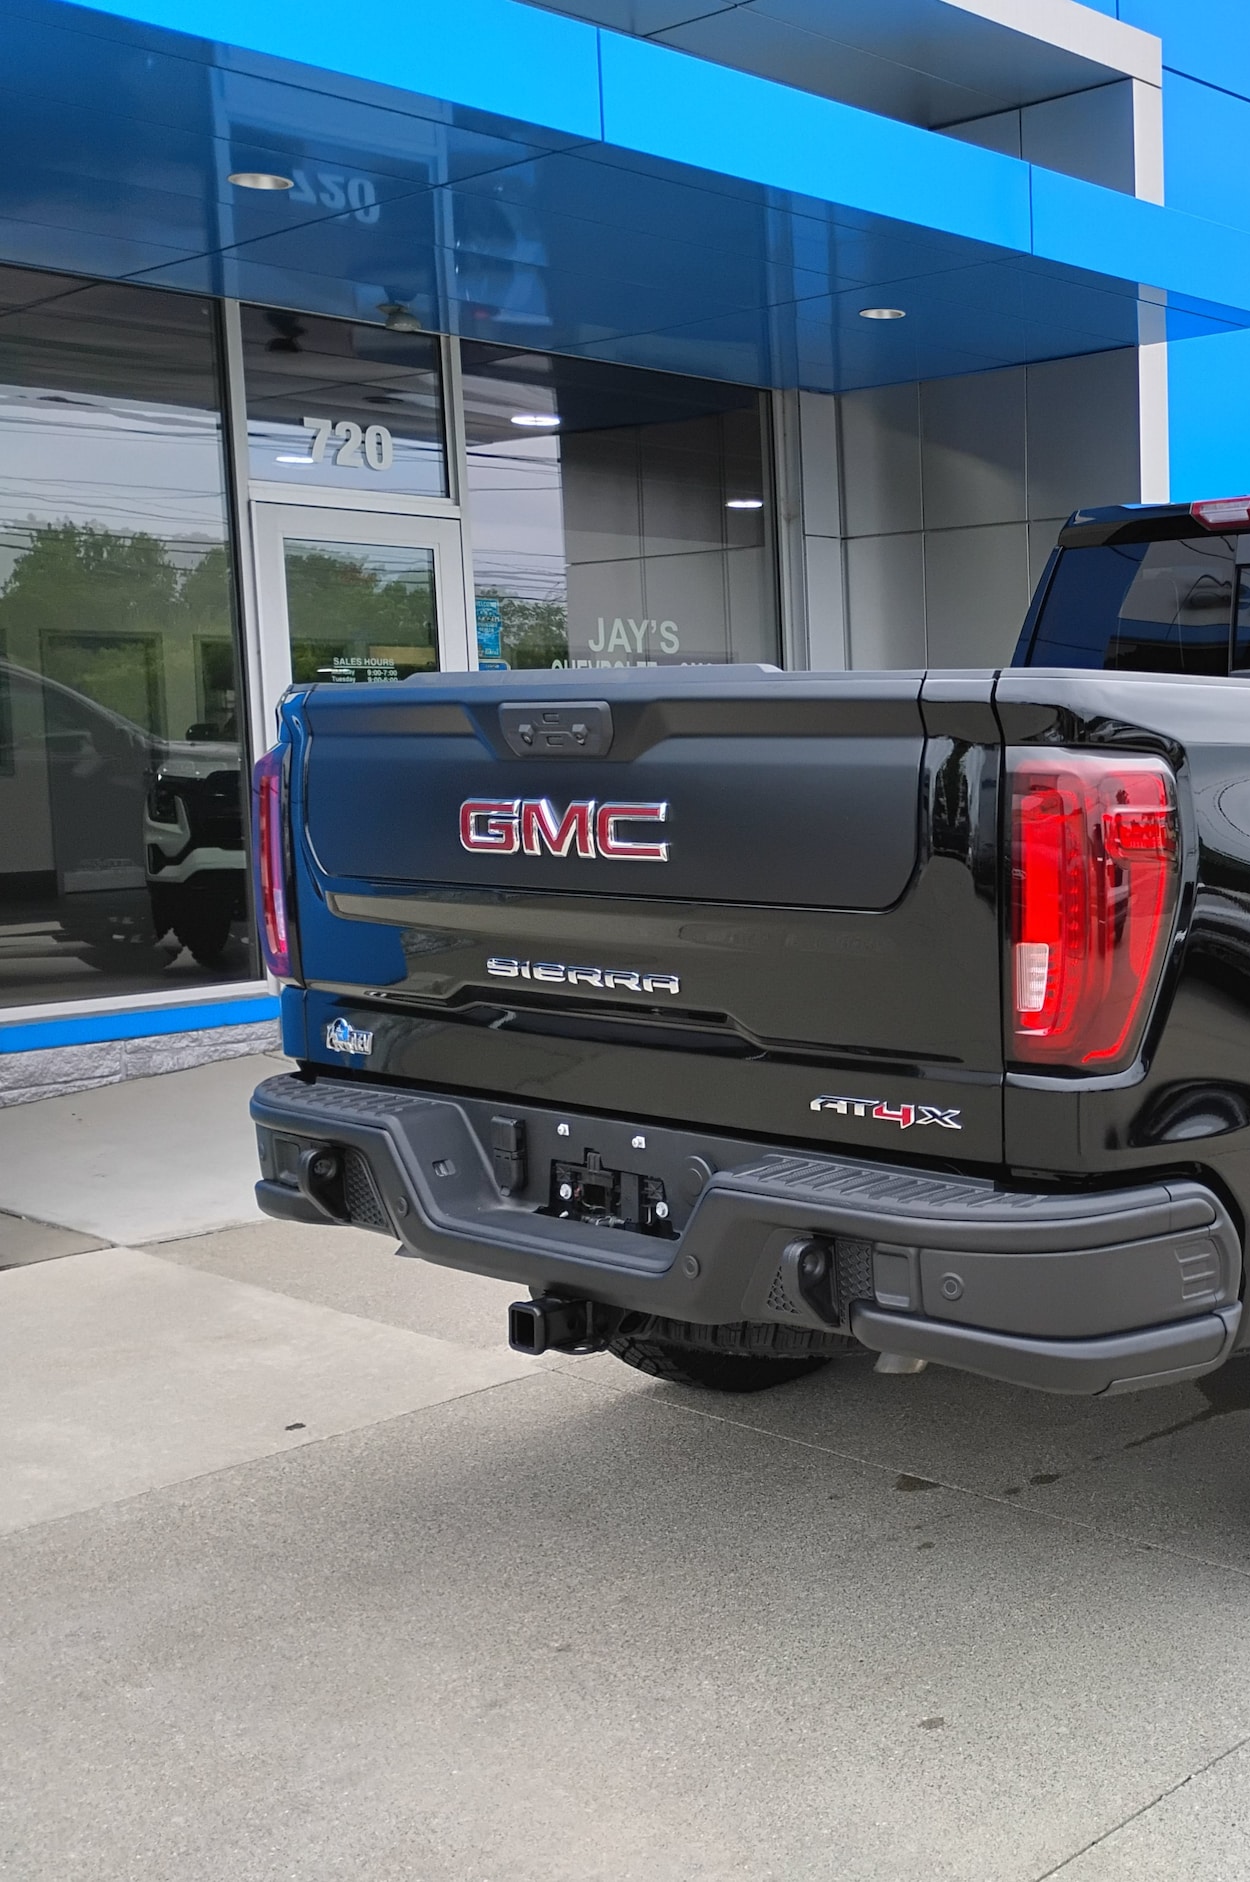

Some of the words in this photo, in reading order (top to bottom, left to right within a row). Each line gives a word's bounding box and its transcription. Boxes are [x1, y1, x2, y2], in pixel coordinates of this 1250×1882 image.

[303, 416, 393, 471] 720
[588, 617, 680, 654] JAY'S
[333, 657, 362, 666] SALES
[364, 658, 395, 666] HOURS
[460, 798, 671, 862] GMC
[486, 957, 681, 995] SIERRA
[810, 1094, 962, 1130] AT4X
